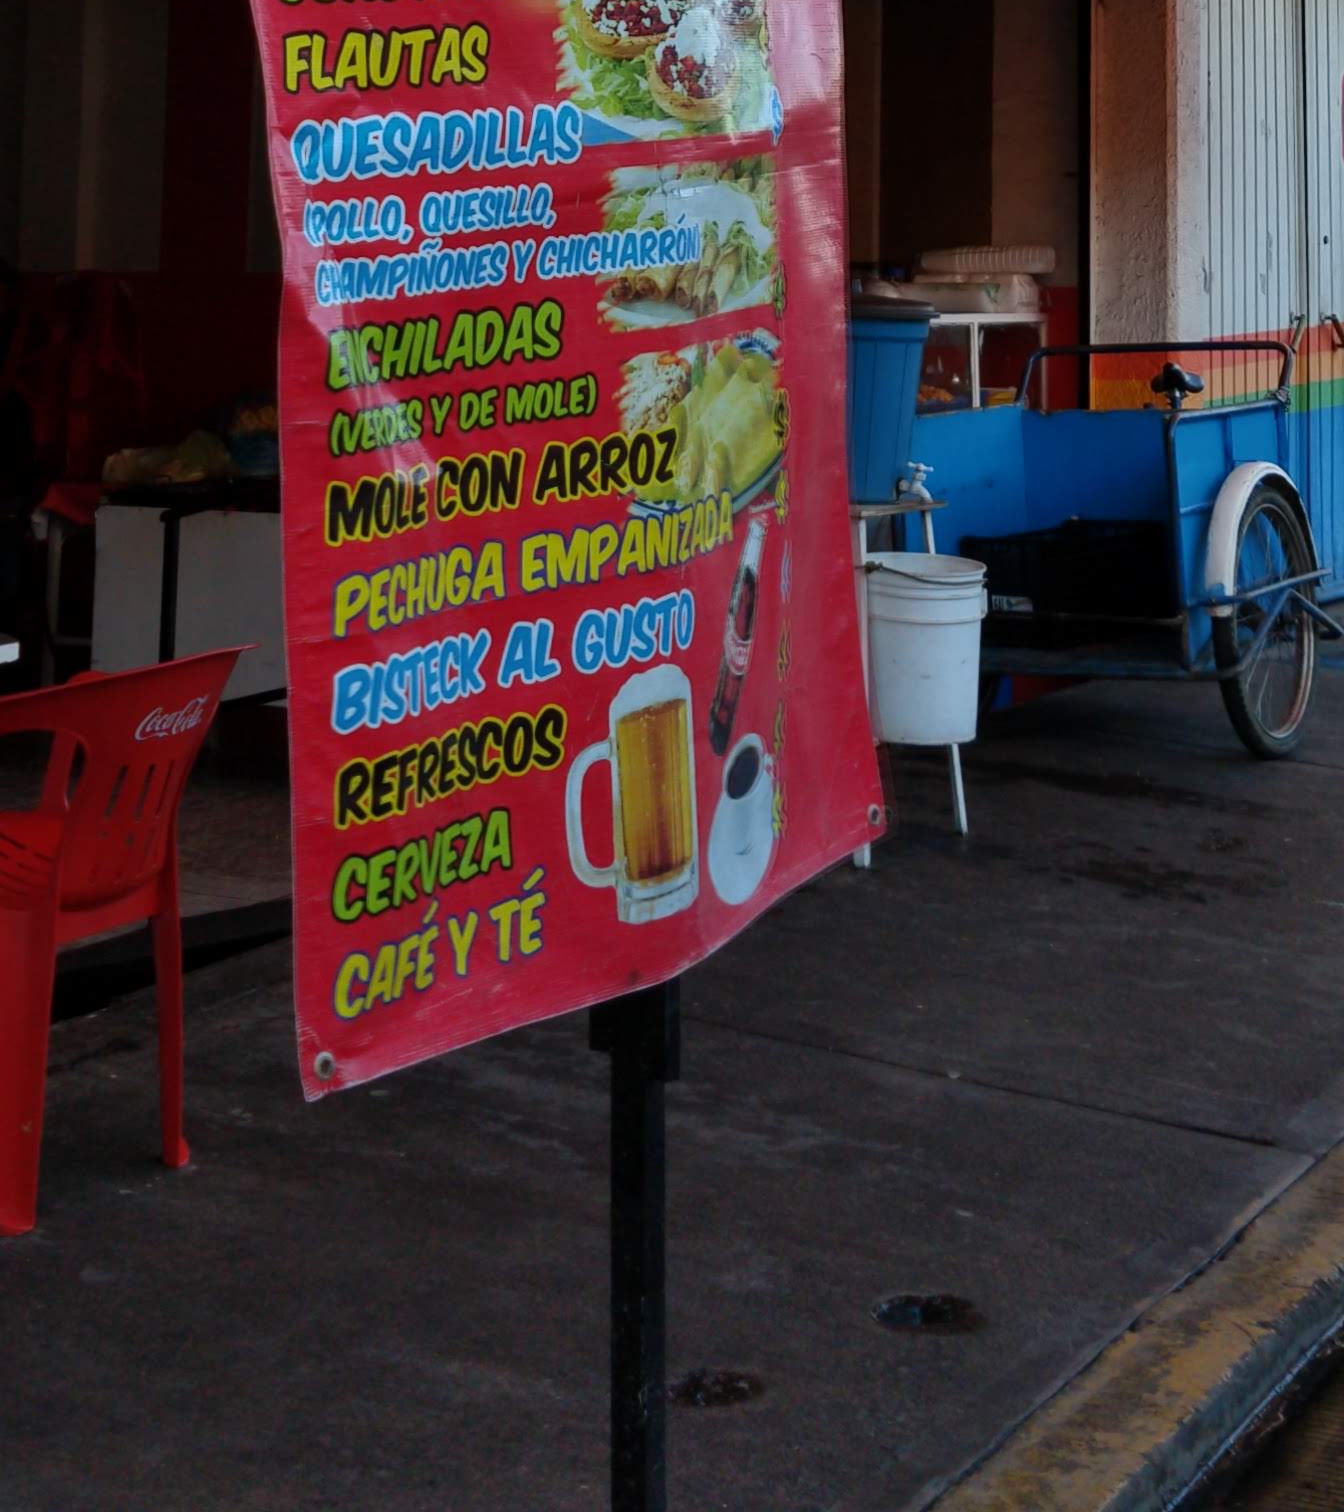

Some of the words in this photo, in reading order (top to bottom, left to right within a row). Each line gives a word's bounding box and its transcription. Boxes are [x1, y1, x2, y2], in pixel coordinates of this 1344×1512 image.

[282, 21, 490, 94] FLAUTAS
[291, 100, 584, 185] QUESADILLAS
[419, 183, 557, 233] QUESILLO,
[513, 241, 534, 283] Y
[430, 393, 452, 435] Y
[457, 389, 499, 432] DE
[504, 372, 598, 420] MOLE)
[324, 467, 429, 546] MOLE
[435, 445, 526, 520] CON
[533, 427, 678, 505] ARROZ
[331, 542, 506, 640] PECHUGA
[520, 492, 735, 595] EMPANIZADA
[330, 622, 492, 735] BISTECK
[498, 618, 561, 688] AL
[573, 588, 697, 673] GUSTO
[332, 703, 569, 830] REFRESCOS
[329, 806, 513, 924] CERVEZA
[332, 902, 440, 1021] CAFÉ
[450, 909, 480, 978] Y
[492, 867, 548, 967] TÉ
